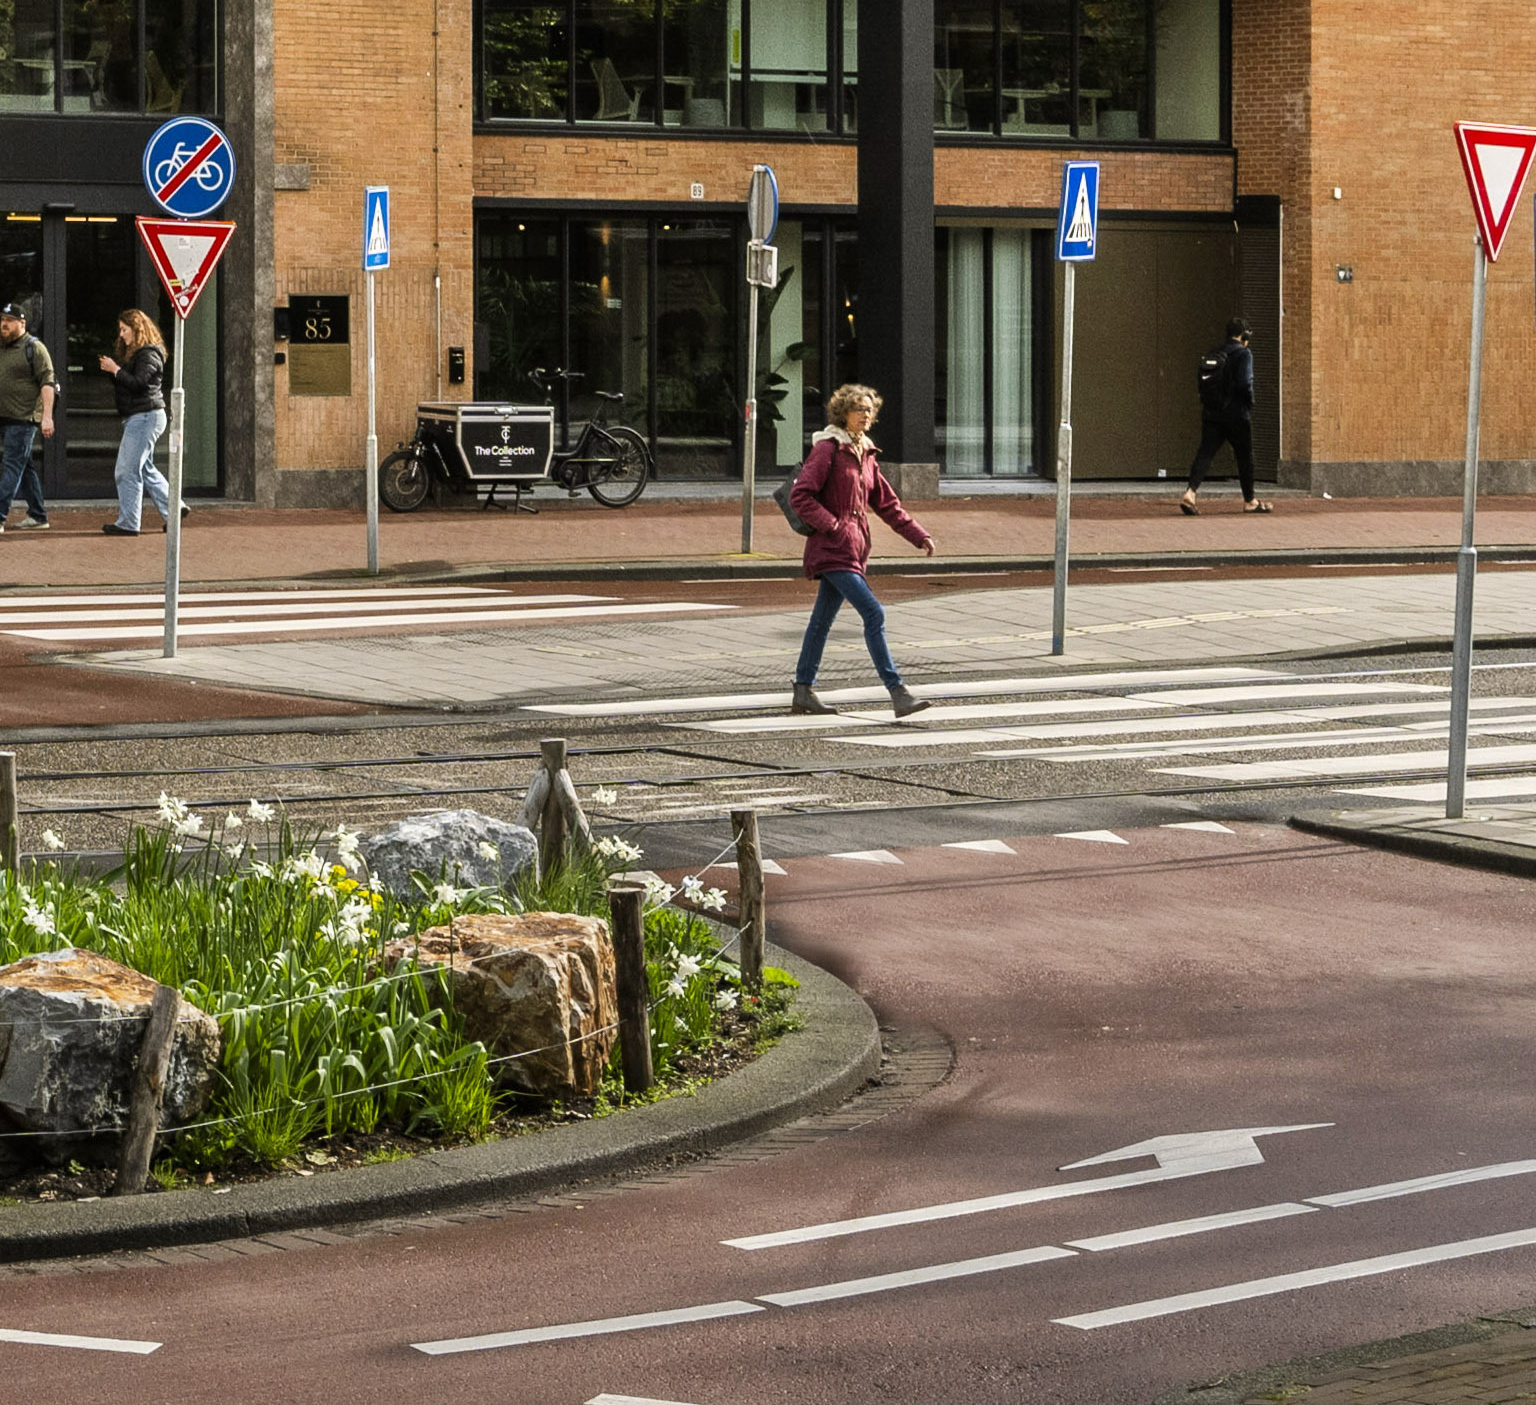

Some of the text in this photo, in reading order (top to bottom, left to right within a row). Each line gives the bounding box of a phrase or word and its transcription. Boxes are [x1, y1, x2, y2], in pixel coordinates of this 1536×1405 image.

[305, 317, 332, 340] 85
[474, 445, 535, 456] The Collection
